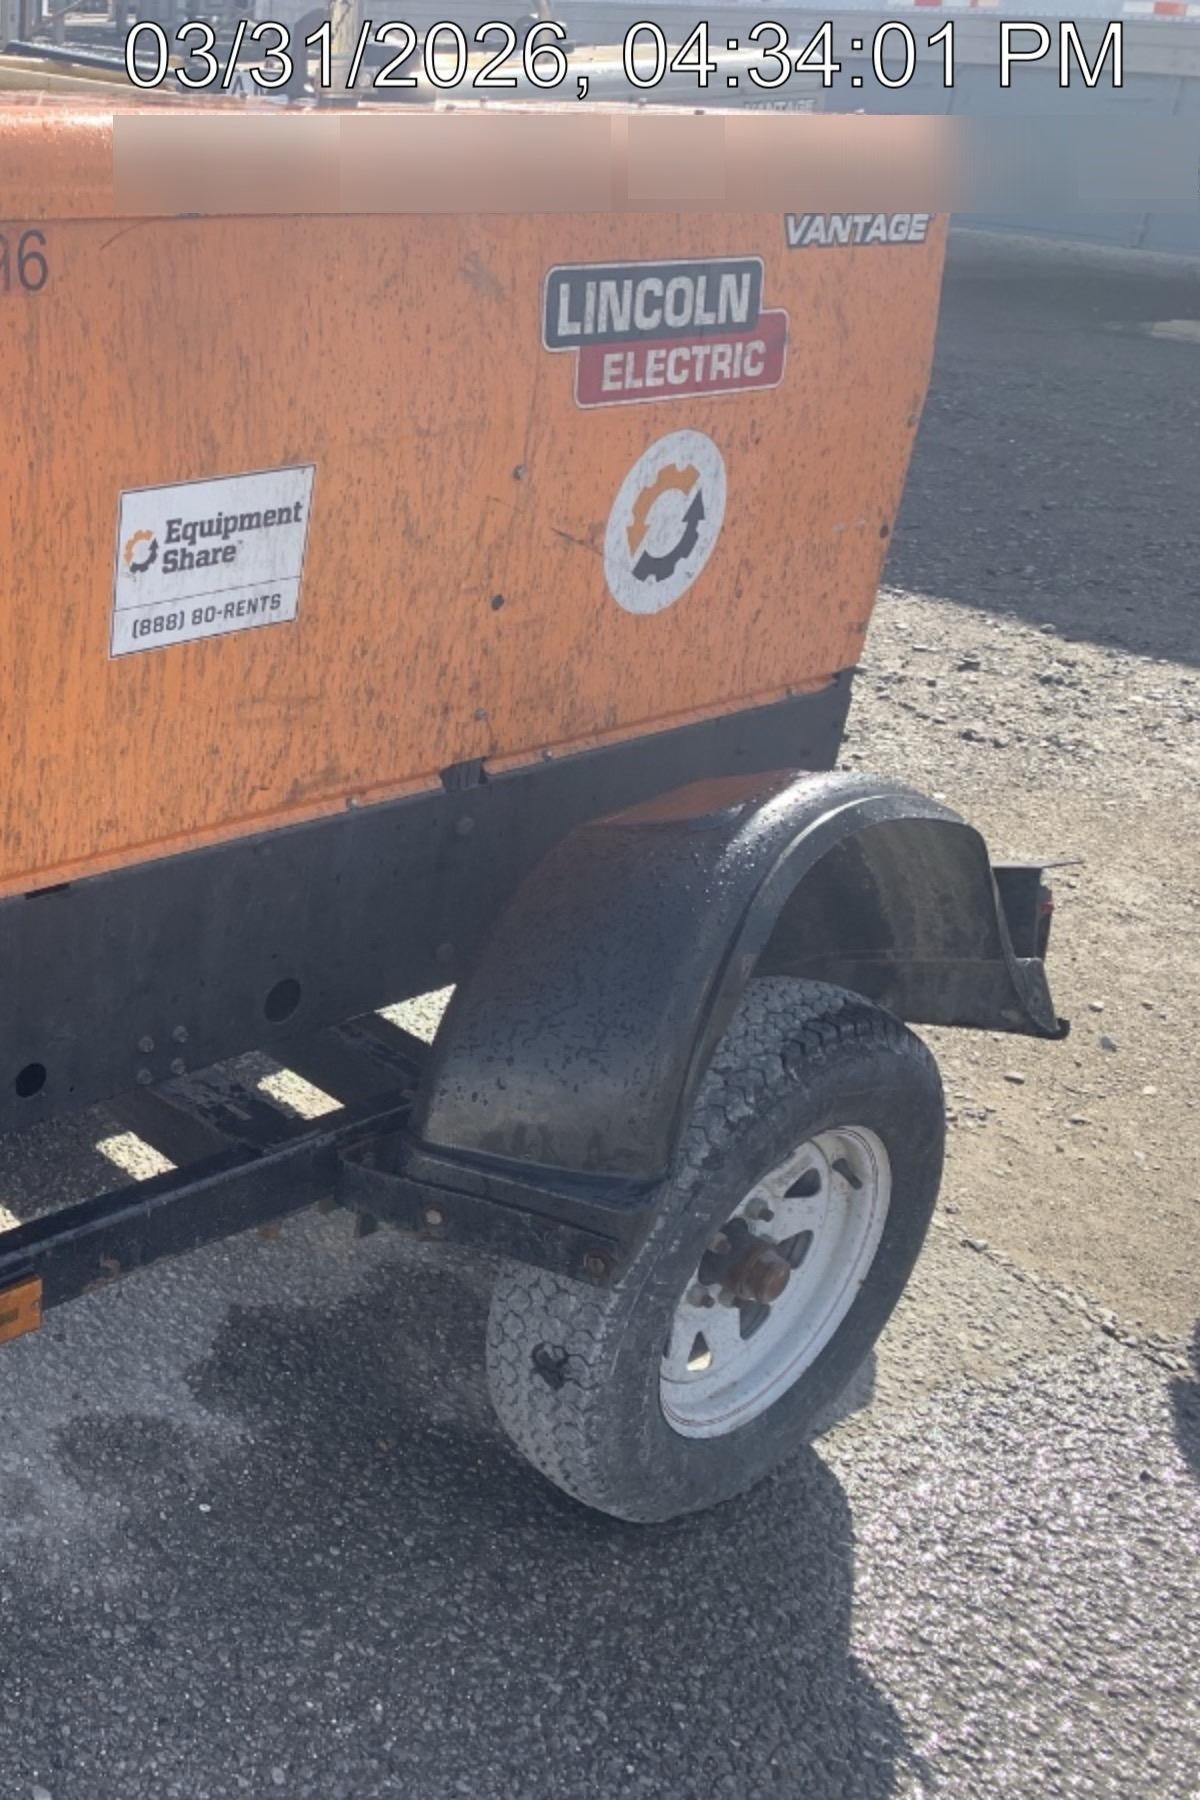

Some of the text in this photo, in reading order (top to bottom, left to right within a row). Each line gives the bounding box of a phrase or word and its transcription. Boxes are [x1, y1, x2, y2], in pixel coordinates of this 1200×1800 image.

[786, 213, 930, 246] VANTAGE
[557, 272, 751, 336] LINCOLN
[602, 340, 767, 392] ELECTRIC
[164, 501, 304, 546] Equipment
[162, 544, 237, 574] Share
[131, 594, 282, 639] (888) 80-RENTS
